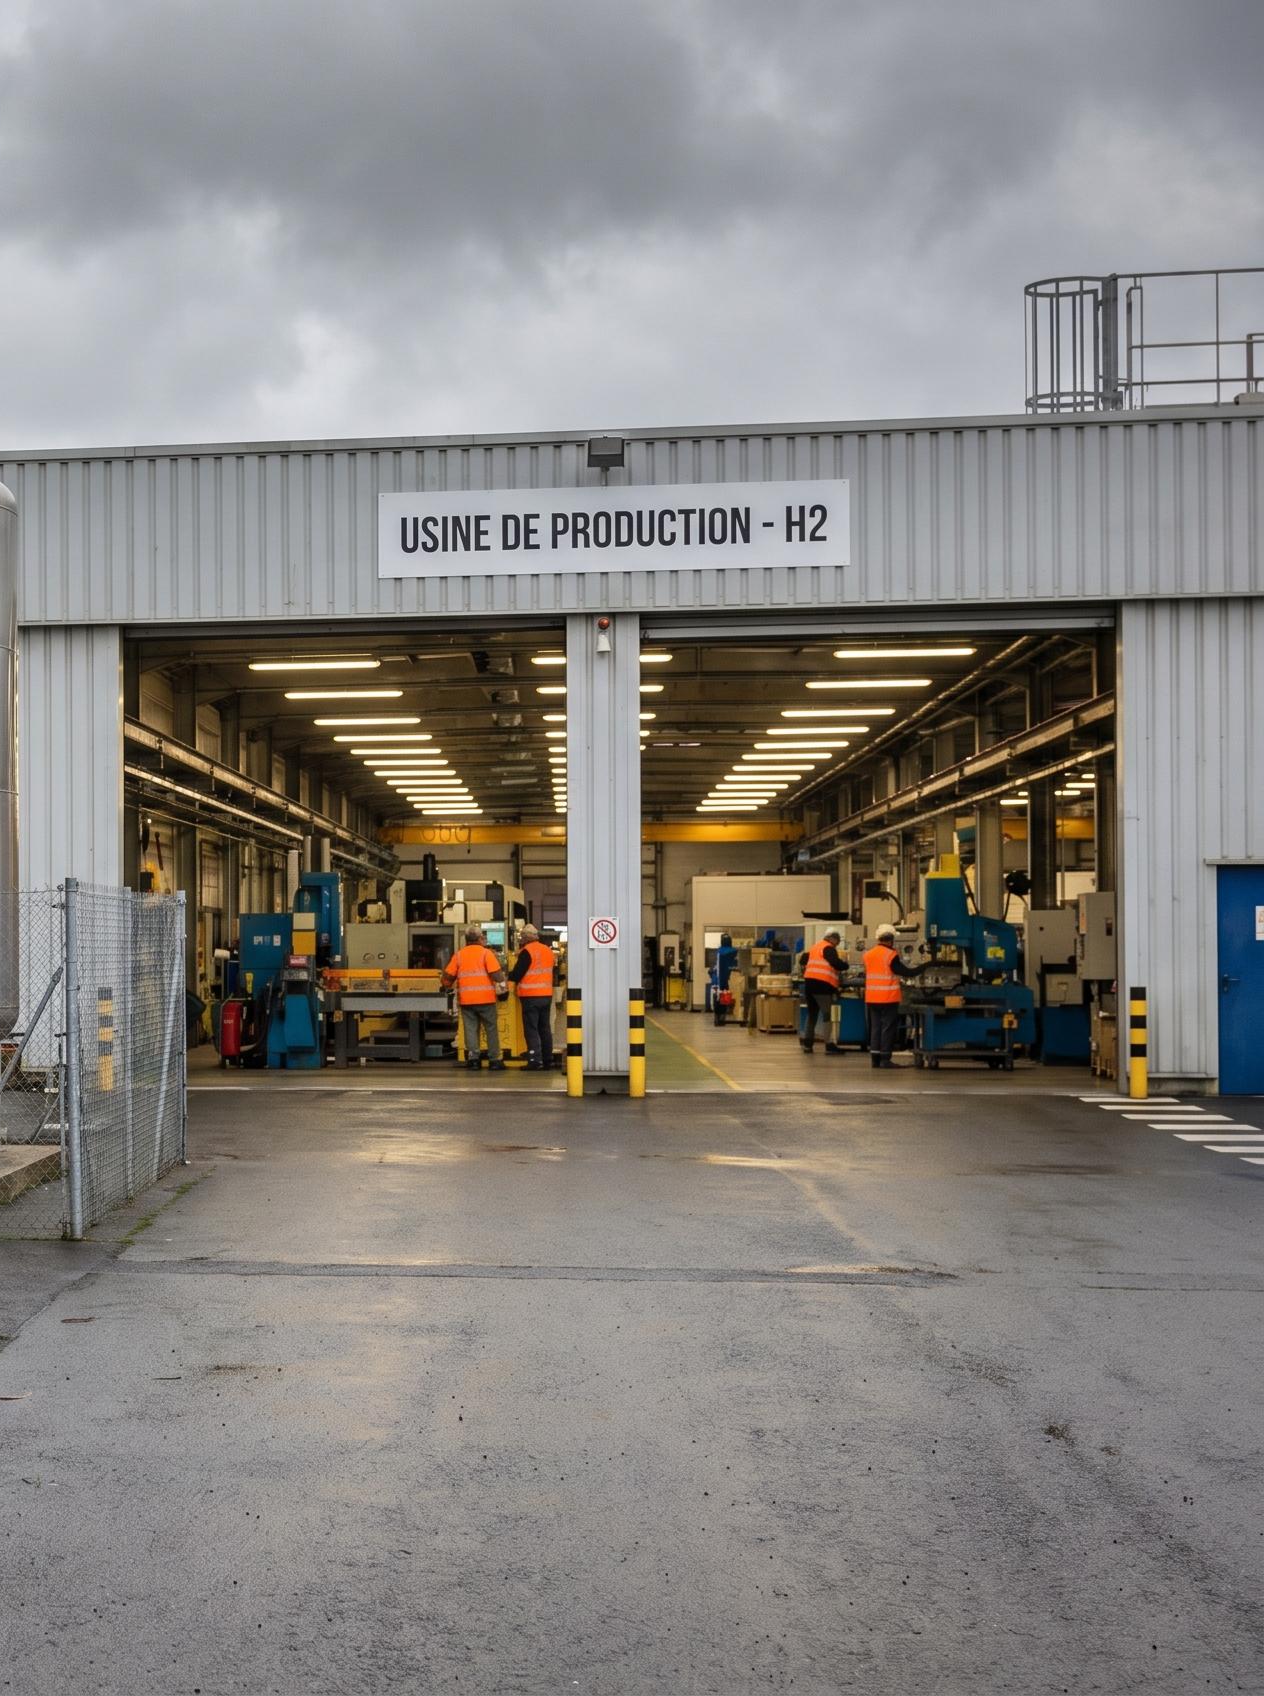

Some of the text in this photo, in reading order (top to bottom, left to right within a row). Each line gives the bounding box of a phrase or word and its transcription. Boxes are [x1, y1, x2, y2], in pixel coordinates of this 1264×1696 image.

[400, 515, 491, 553] USINE
[501, 513, 541, 551] DE
[551, 506, 751, 550] PRODUCTION
[785, 504, 828, 543] H2
